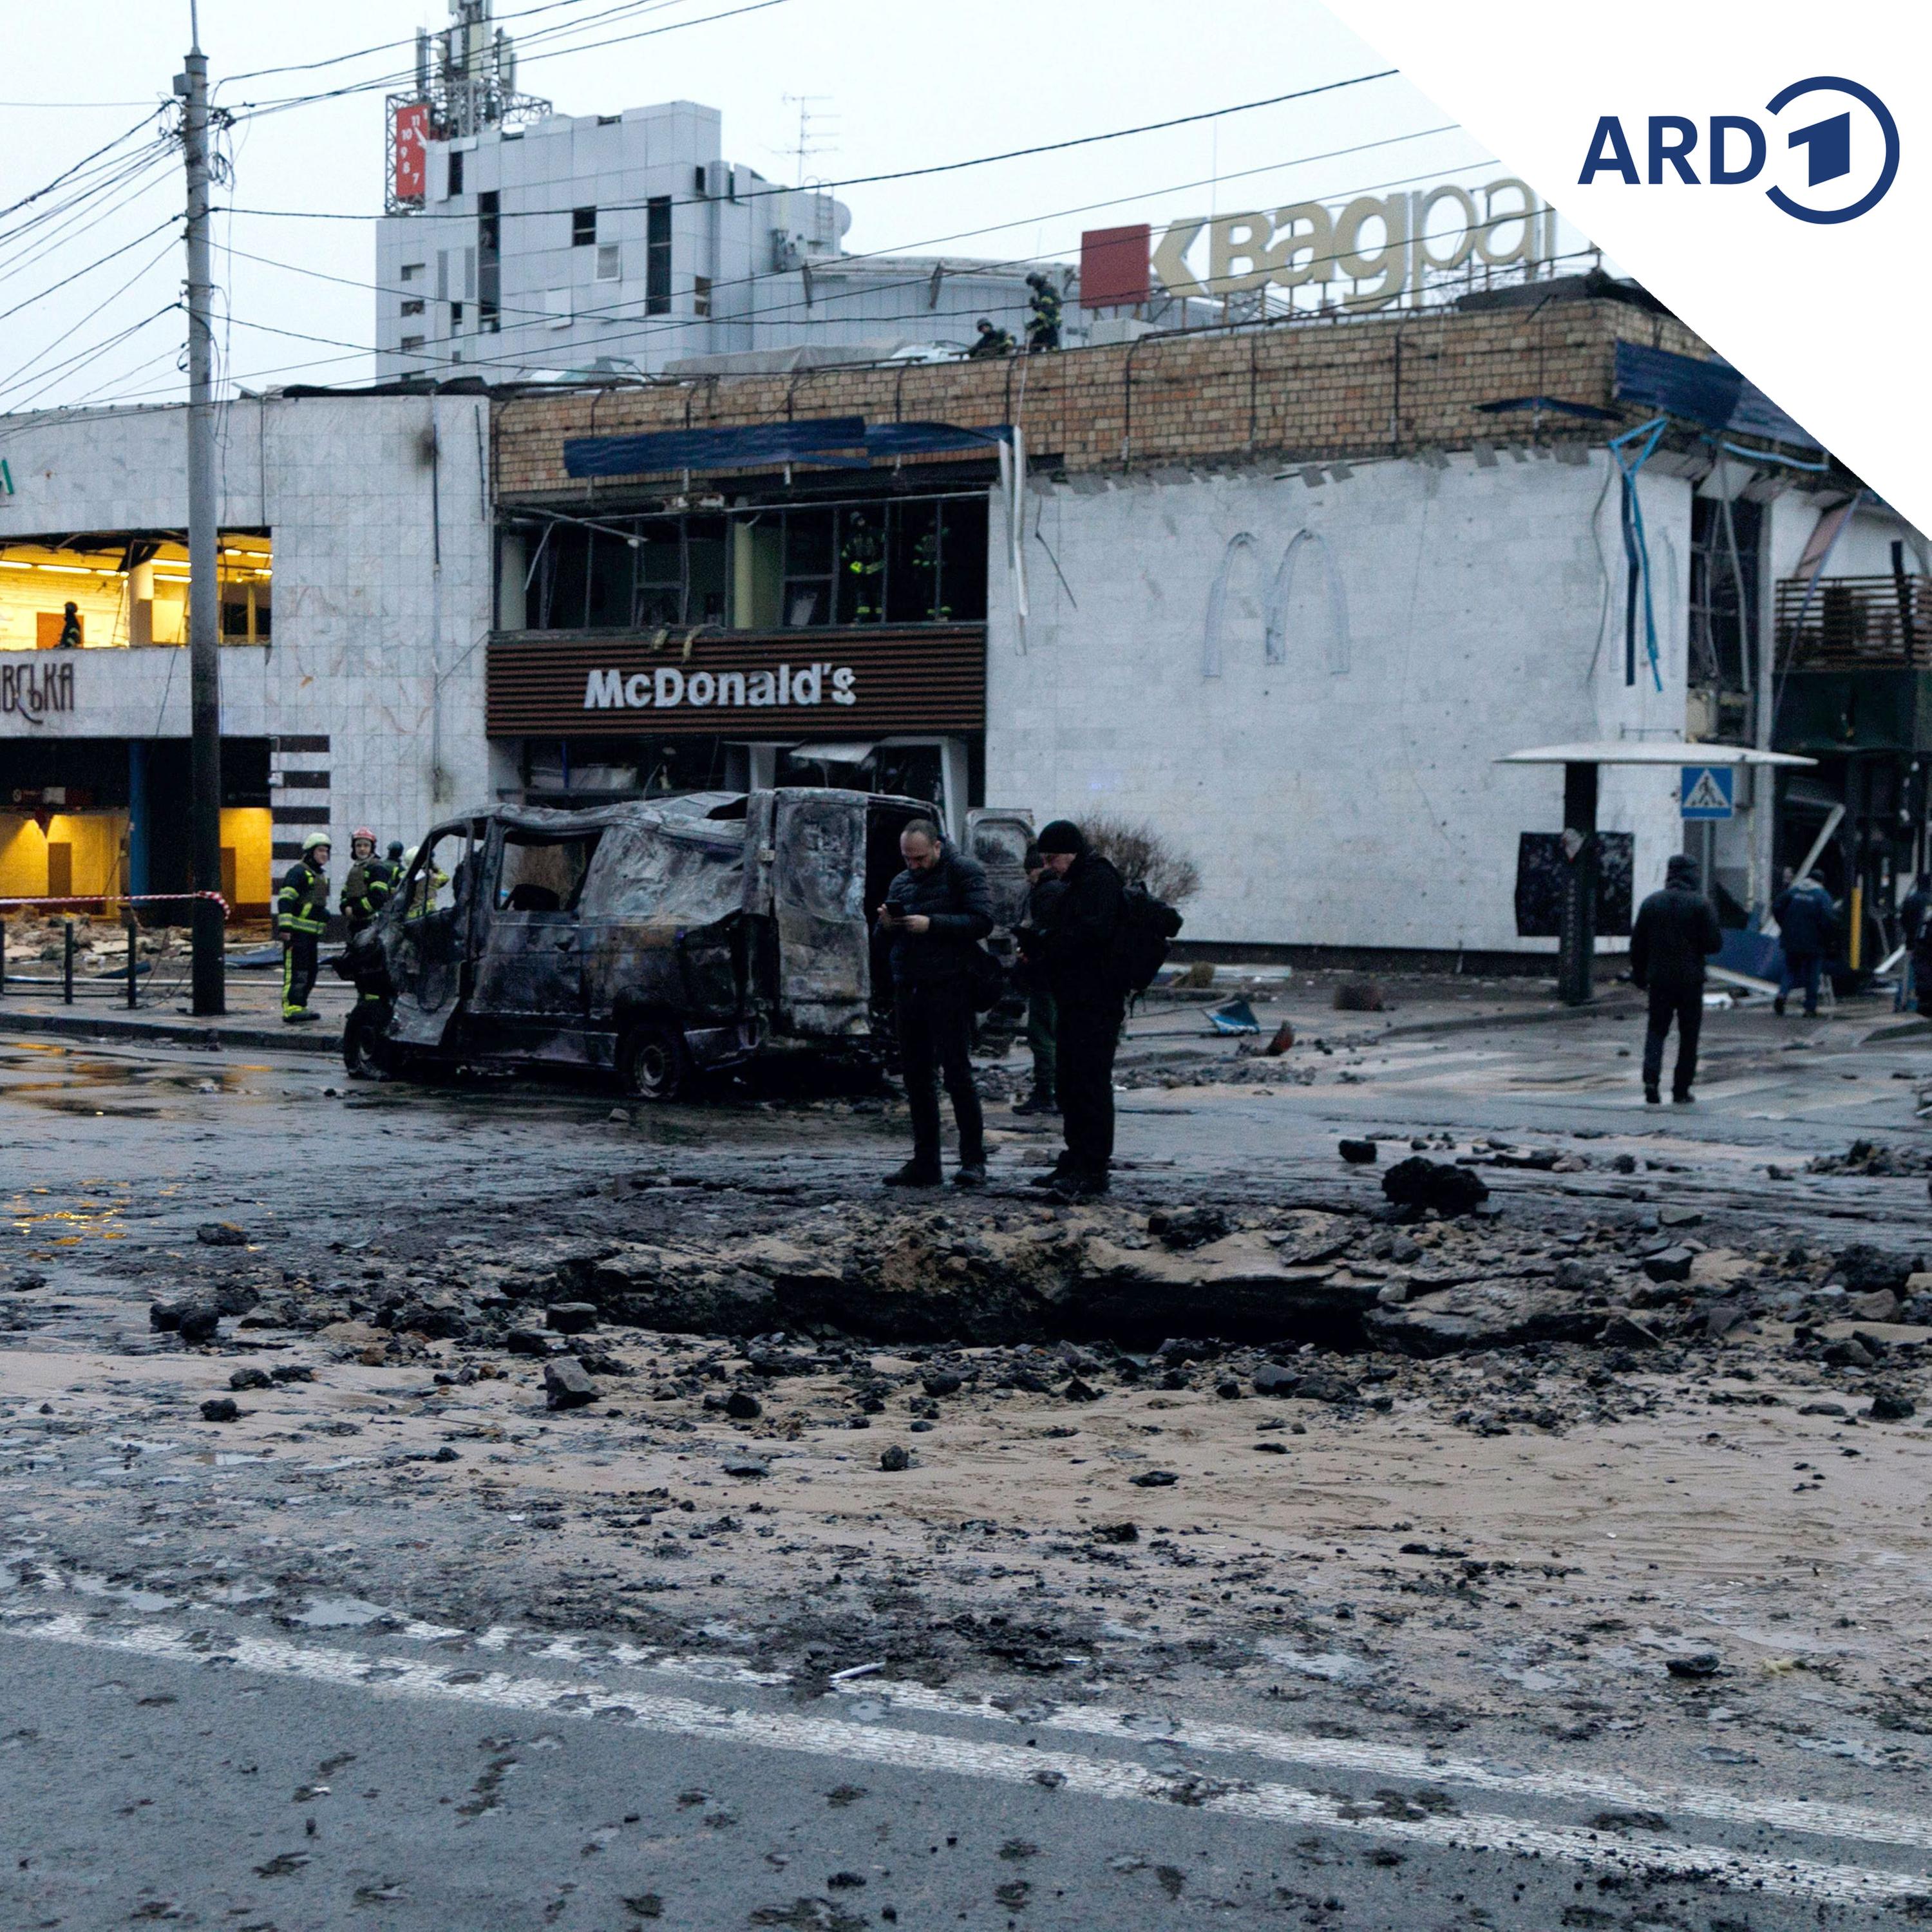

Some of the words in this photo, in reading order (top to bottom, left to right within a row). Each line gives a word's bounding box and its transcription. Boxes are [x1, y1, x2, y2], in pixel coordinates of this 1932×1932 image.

[401, 146, 408, 158] 9
[413, 173, 421, 184] 7
[583, 663, 857, 708] McDonald's
